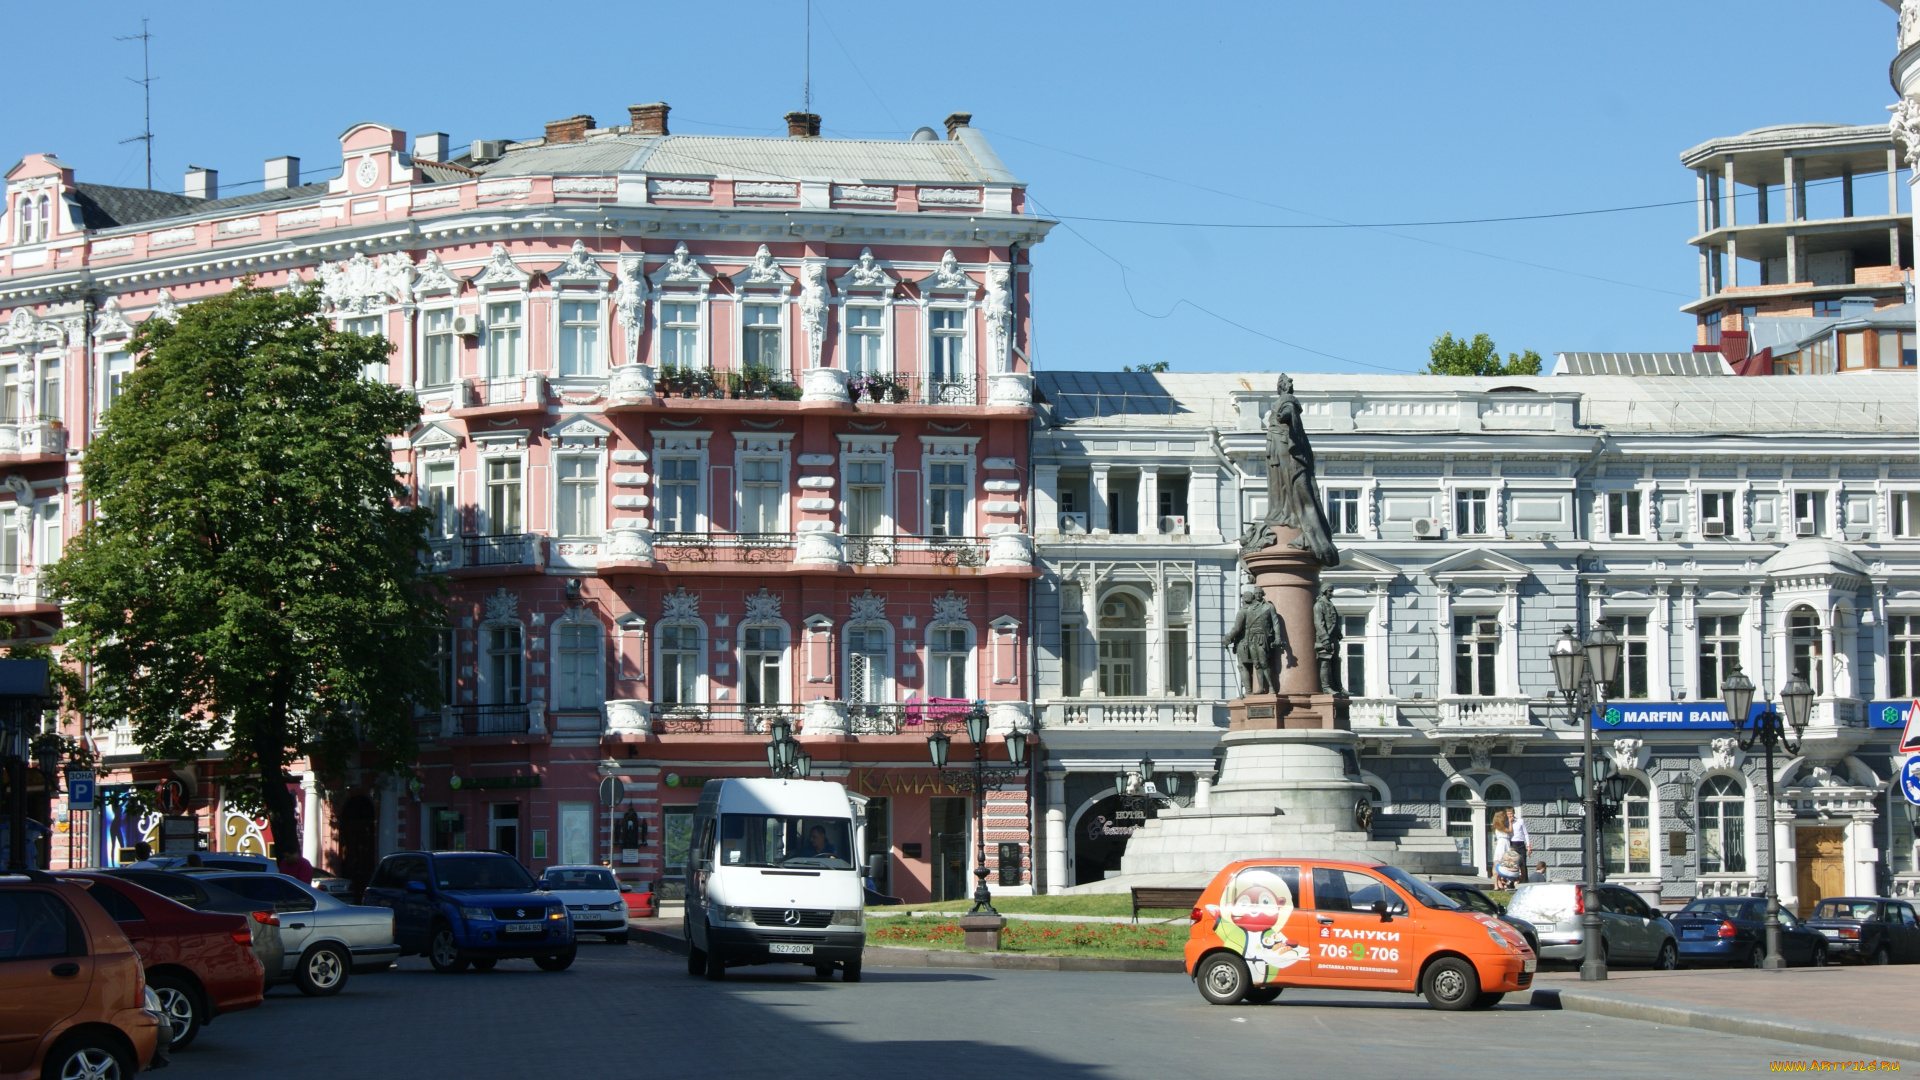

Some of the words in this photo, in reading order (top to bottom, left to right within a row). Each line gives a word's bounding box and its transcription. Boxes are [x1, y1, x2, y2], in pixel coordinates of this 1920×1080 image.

[1624, 711, 1683, 723] MARFIN
[70, 772, 94, 780] ЗОНА
[75, 784, 88, 799] P
[1115, 811, 1146, 819] HOTEL
[1333, 928, 1399, 941] ТАНУКИ
